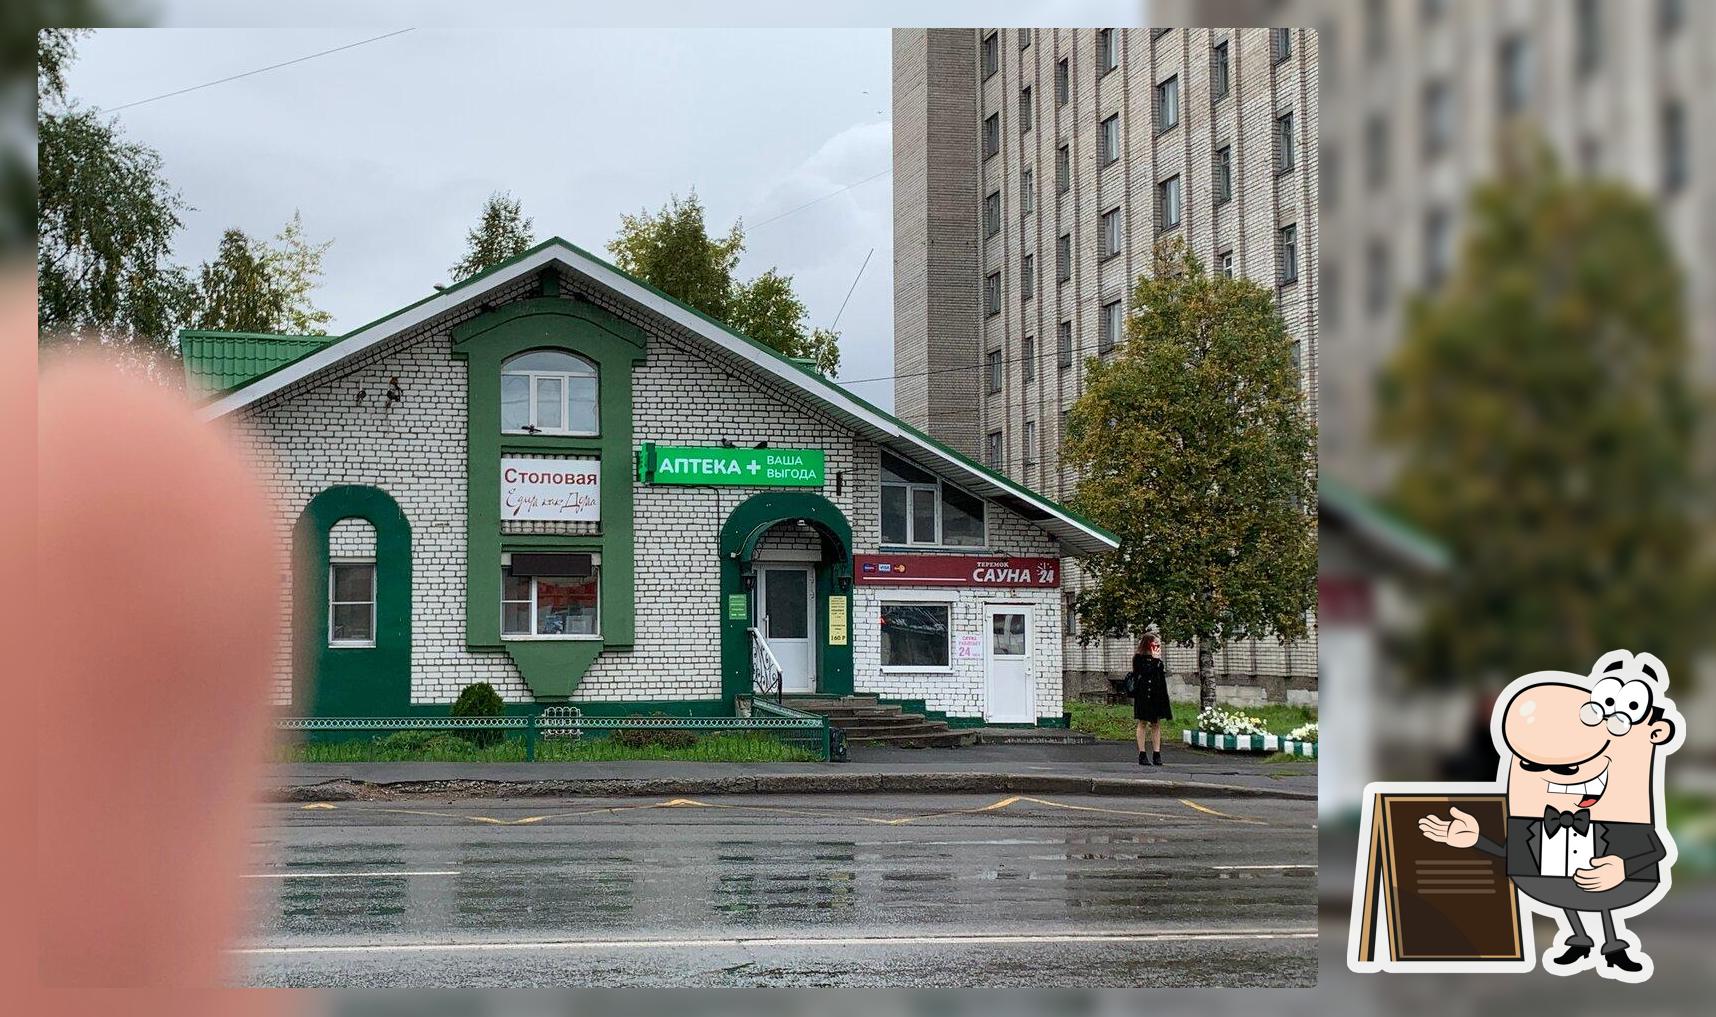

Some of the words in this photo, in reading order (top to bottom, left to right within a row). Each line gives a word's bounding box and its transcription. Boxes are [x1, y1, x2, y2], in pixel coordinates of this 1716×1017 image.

[659, 458, 742, 475] АПТЕКА
[766, 455, 803, 466] ВАША
[504, 468, 598, 486] Столовая
[766, 468, 817, 480] ВЫГОДА
[972, 568, 1032, 583] САУНА
[1038, 569, 1054, 583] 24
[959, 646, 971, 657] 24
